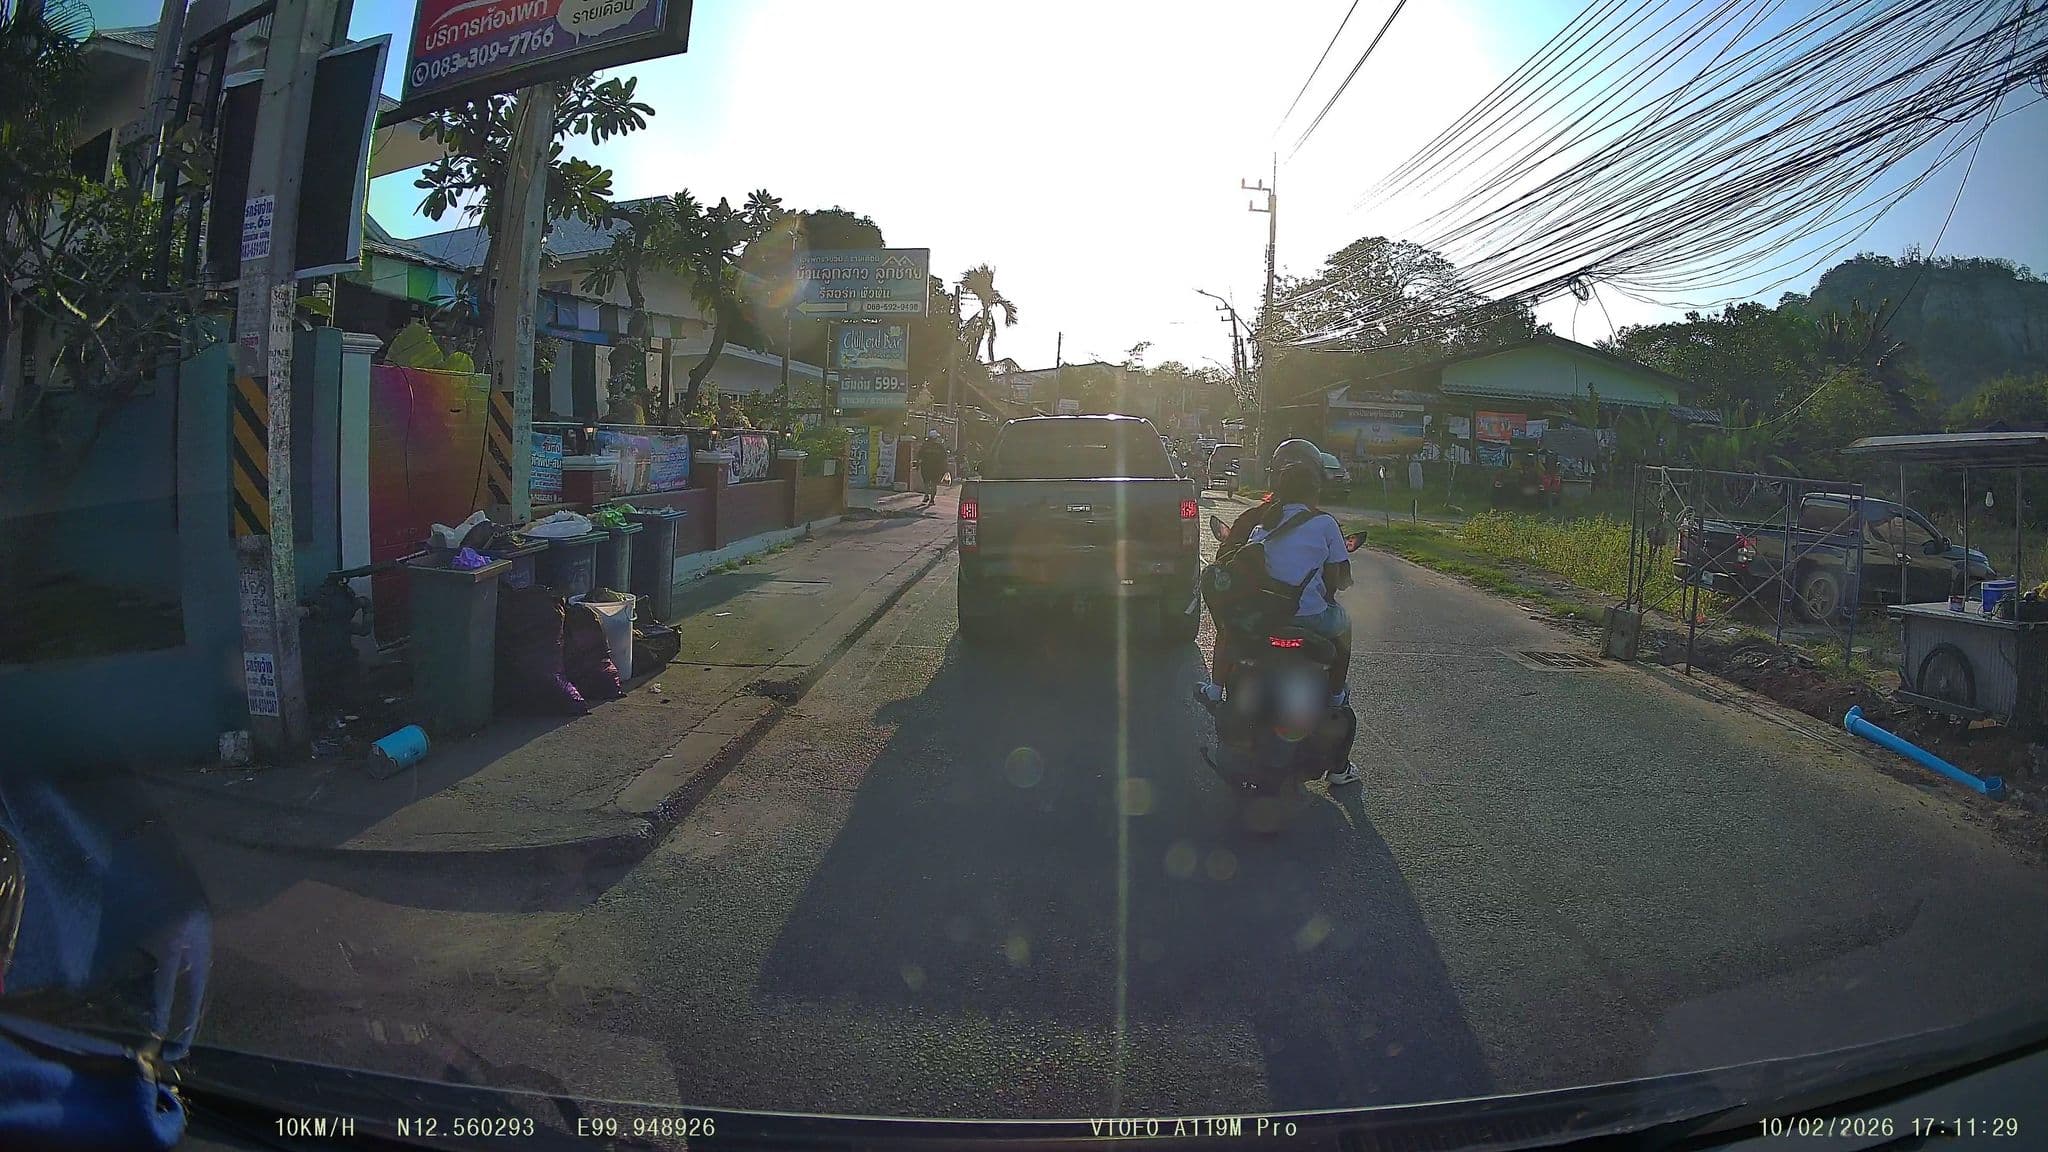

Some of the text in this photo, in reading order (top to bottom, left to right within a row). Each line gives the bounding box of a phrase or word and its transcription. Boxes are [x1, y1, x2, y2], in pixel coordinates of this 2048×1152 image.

[425, 0, 549, 51] บริการห้องพก
[430, 24, 554, 80] 083-309-7766
[796, 263, 922, 285] บ้านลูกสาว ลูกชาย
